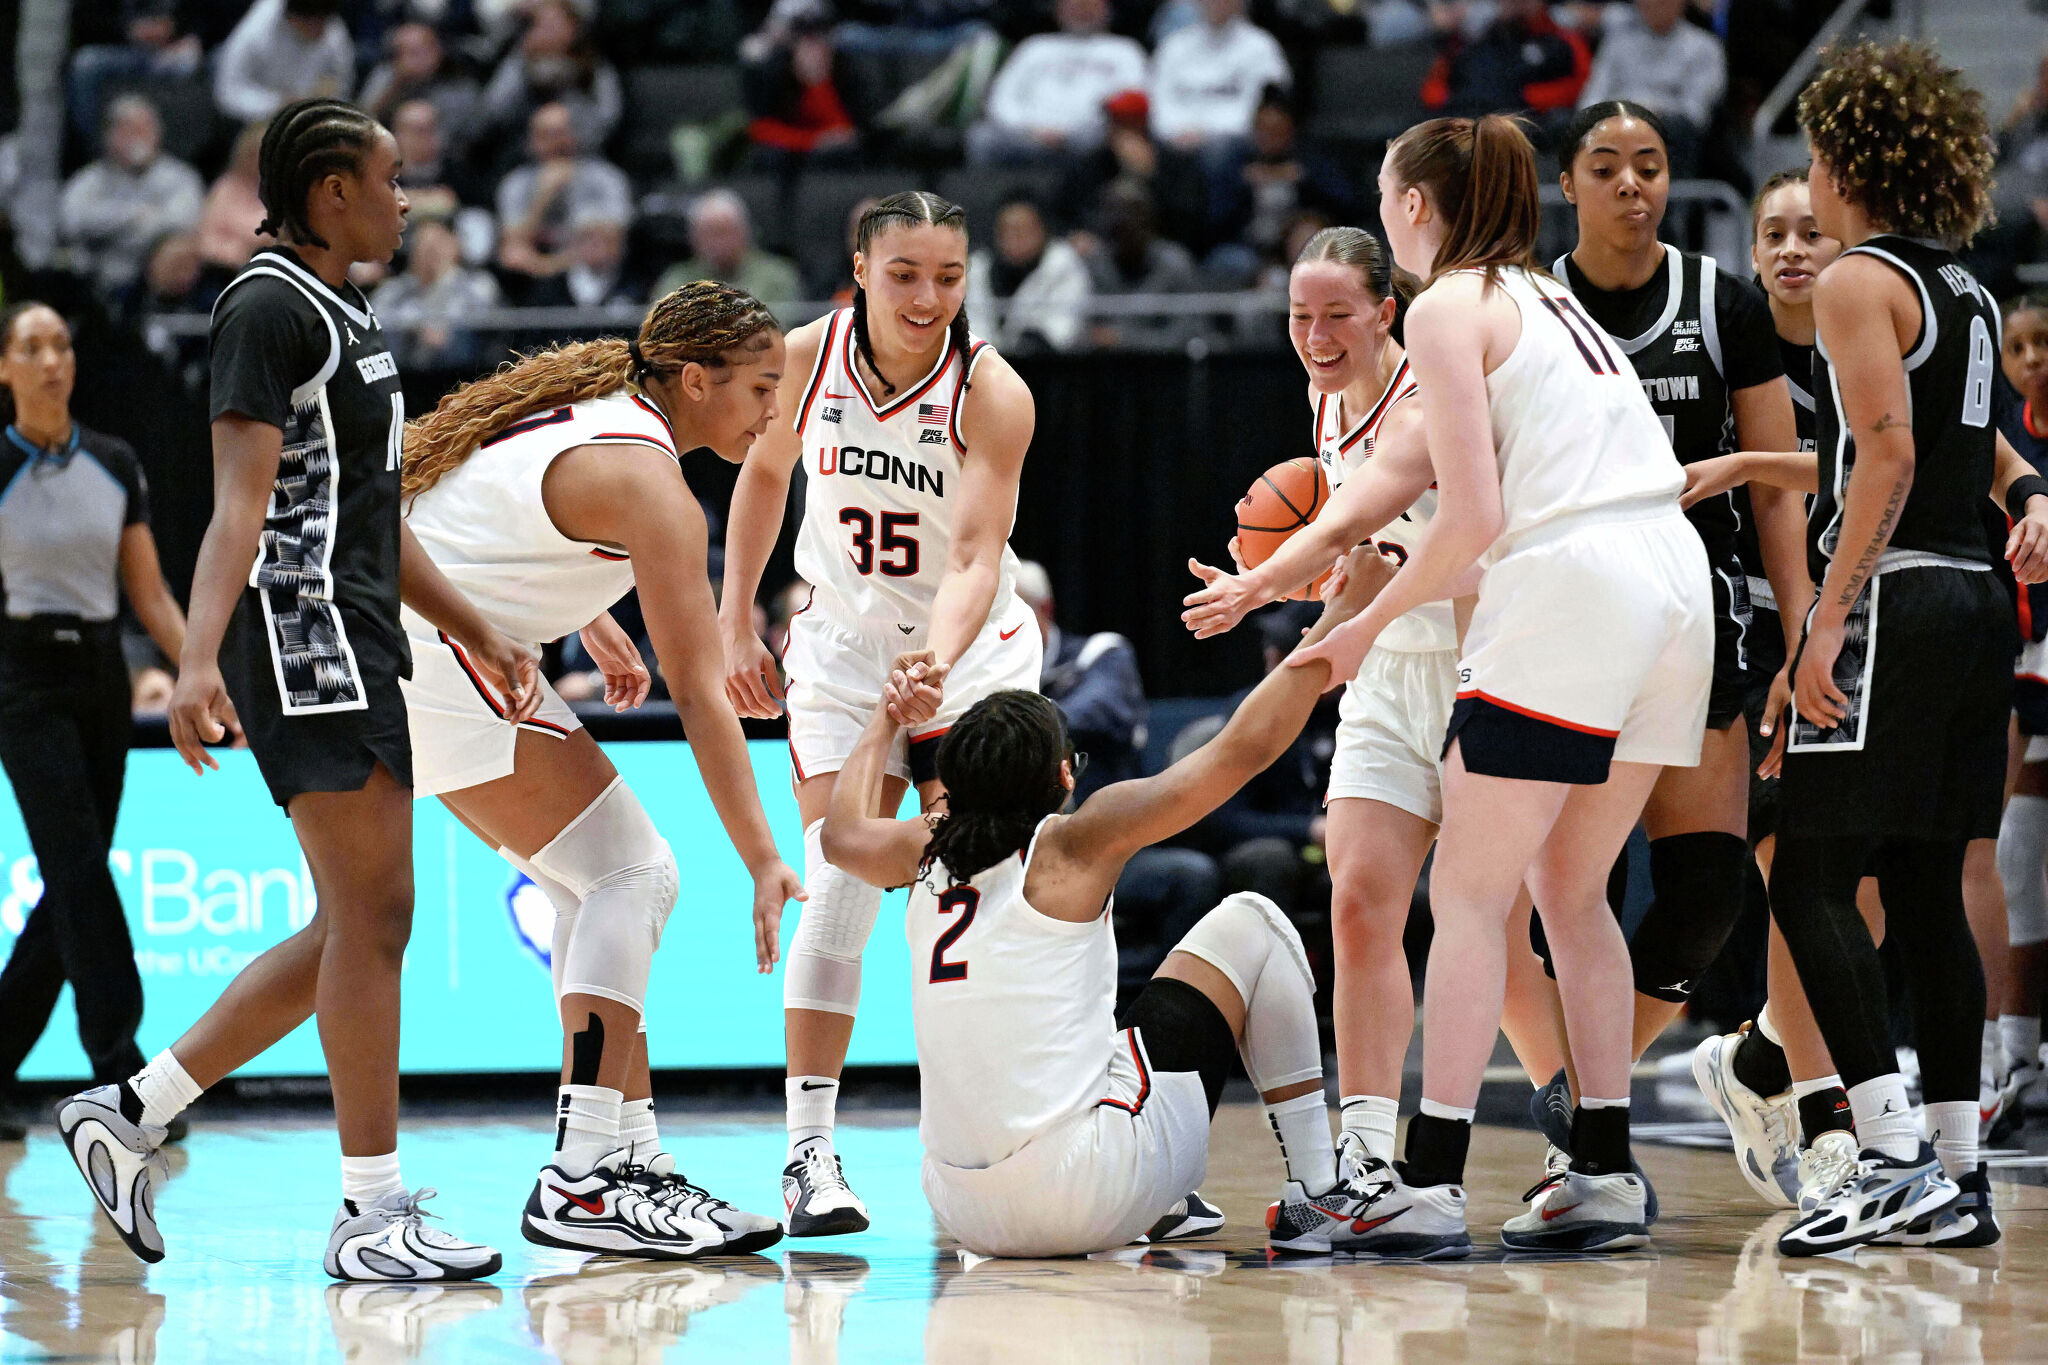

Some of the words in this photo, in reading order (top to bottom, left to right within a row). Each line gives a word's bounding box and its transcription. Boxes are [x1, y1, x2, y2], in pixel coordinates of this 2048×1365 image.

[1538, 296, 1620, 375] 11
[1671, 327, 1700, 335] CHANGE
[1962, 315, 1993, 428] 8
[919, 435, 949, 443] EAST
[922, 428, 943, 437] BIG
[818, 446, 944, 498] UCONN
[838, 506, 920, 577] 35
[928, 884, 981, 984] 2
